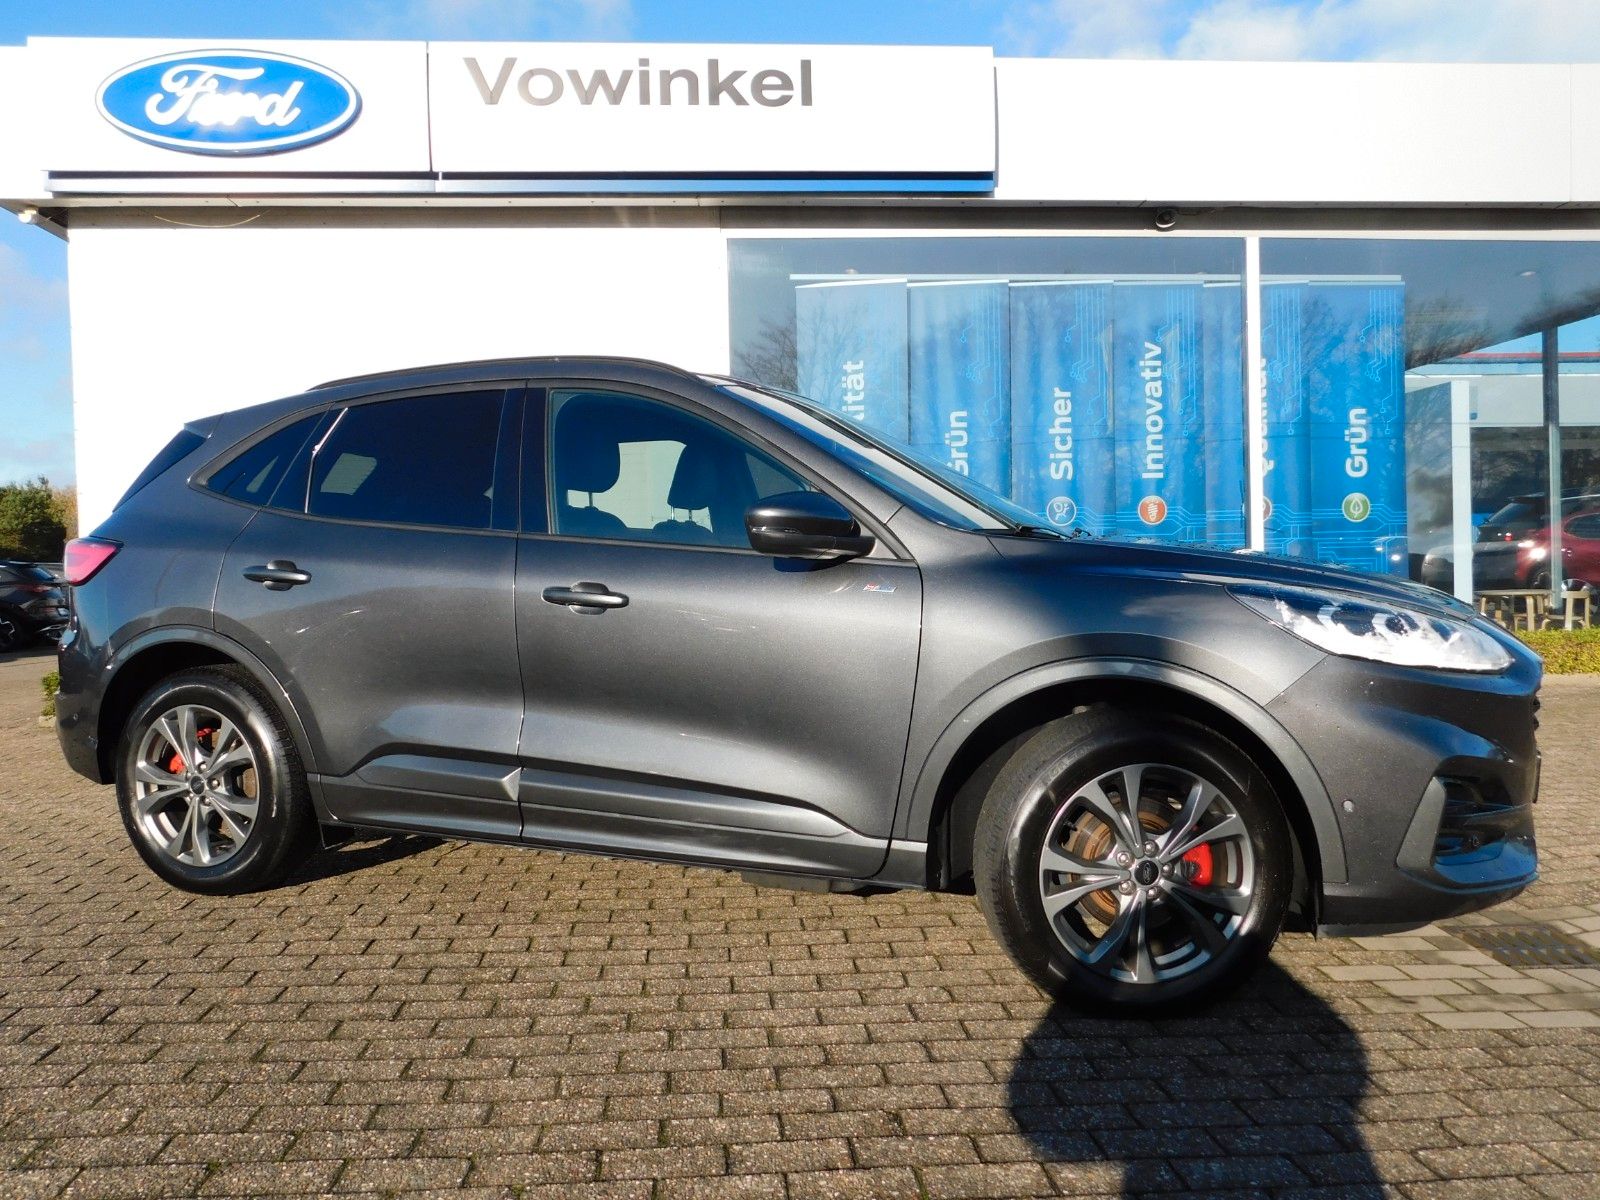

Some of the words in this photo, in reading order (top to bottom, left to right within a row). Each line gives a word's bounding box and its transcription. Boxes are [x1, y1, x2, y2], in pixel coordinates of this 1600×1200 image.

[145, 64, 304, 126] Ford
[463, 57, 812, 107] Vowinkel
[1049, 387, 1074, 480] Sicher
[1139, 341, 1164, 479] Innovativ
[1344, 408, 1369, 478] Grün
